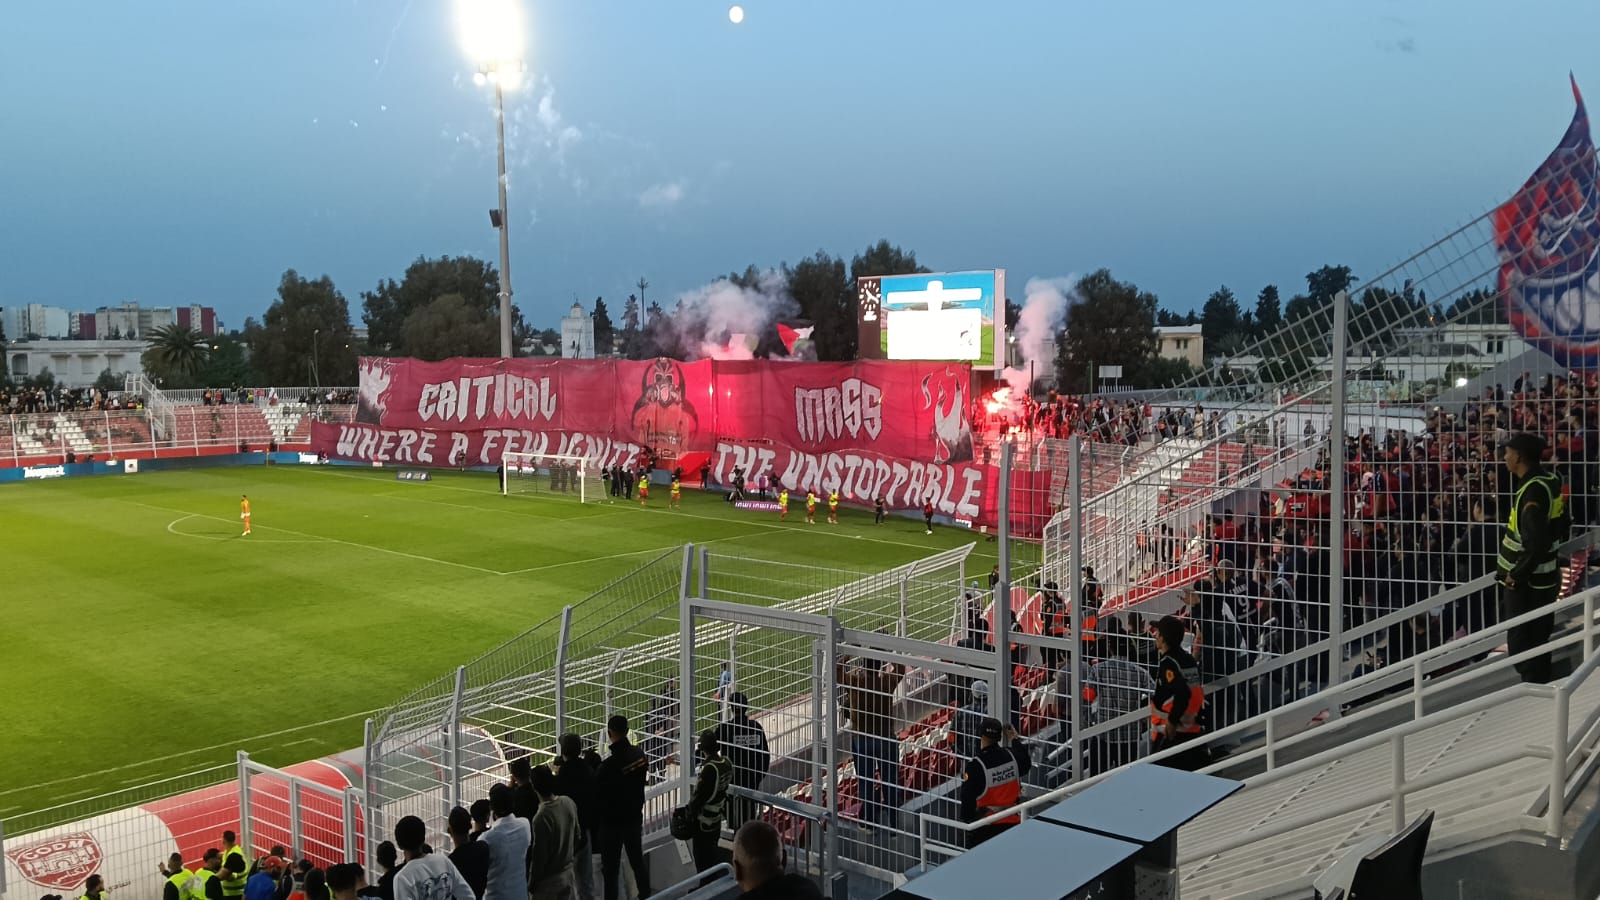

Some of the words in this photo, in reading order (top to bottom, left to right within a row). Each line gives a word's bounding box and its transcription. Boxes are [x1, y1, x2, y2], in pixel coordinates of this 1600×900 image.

[418, 373, 557, 422] CRITICAL
[795, 378, 882, 443] MASS
[336, 425, 437, 462] WHERE
[448, 432, 469, 465] A
[480, 430, 549, 465] FEW
[556, 432, 640, 473] IGNITE
[714, 442, 776, 487] THE
[780, 452, 982, 517] UNSTOPPABLE
[992, 771, 1015, 784] POLICE
[22, 839, 85, 860] CODM
